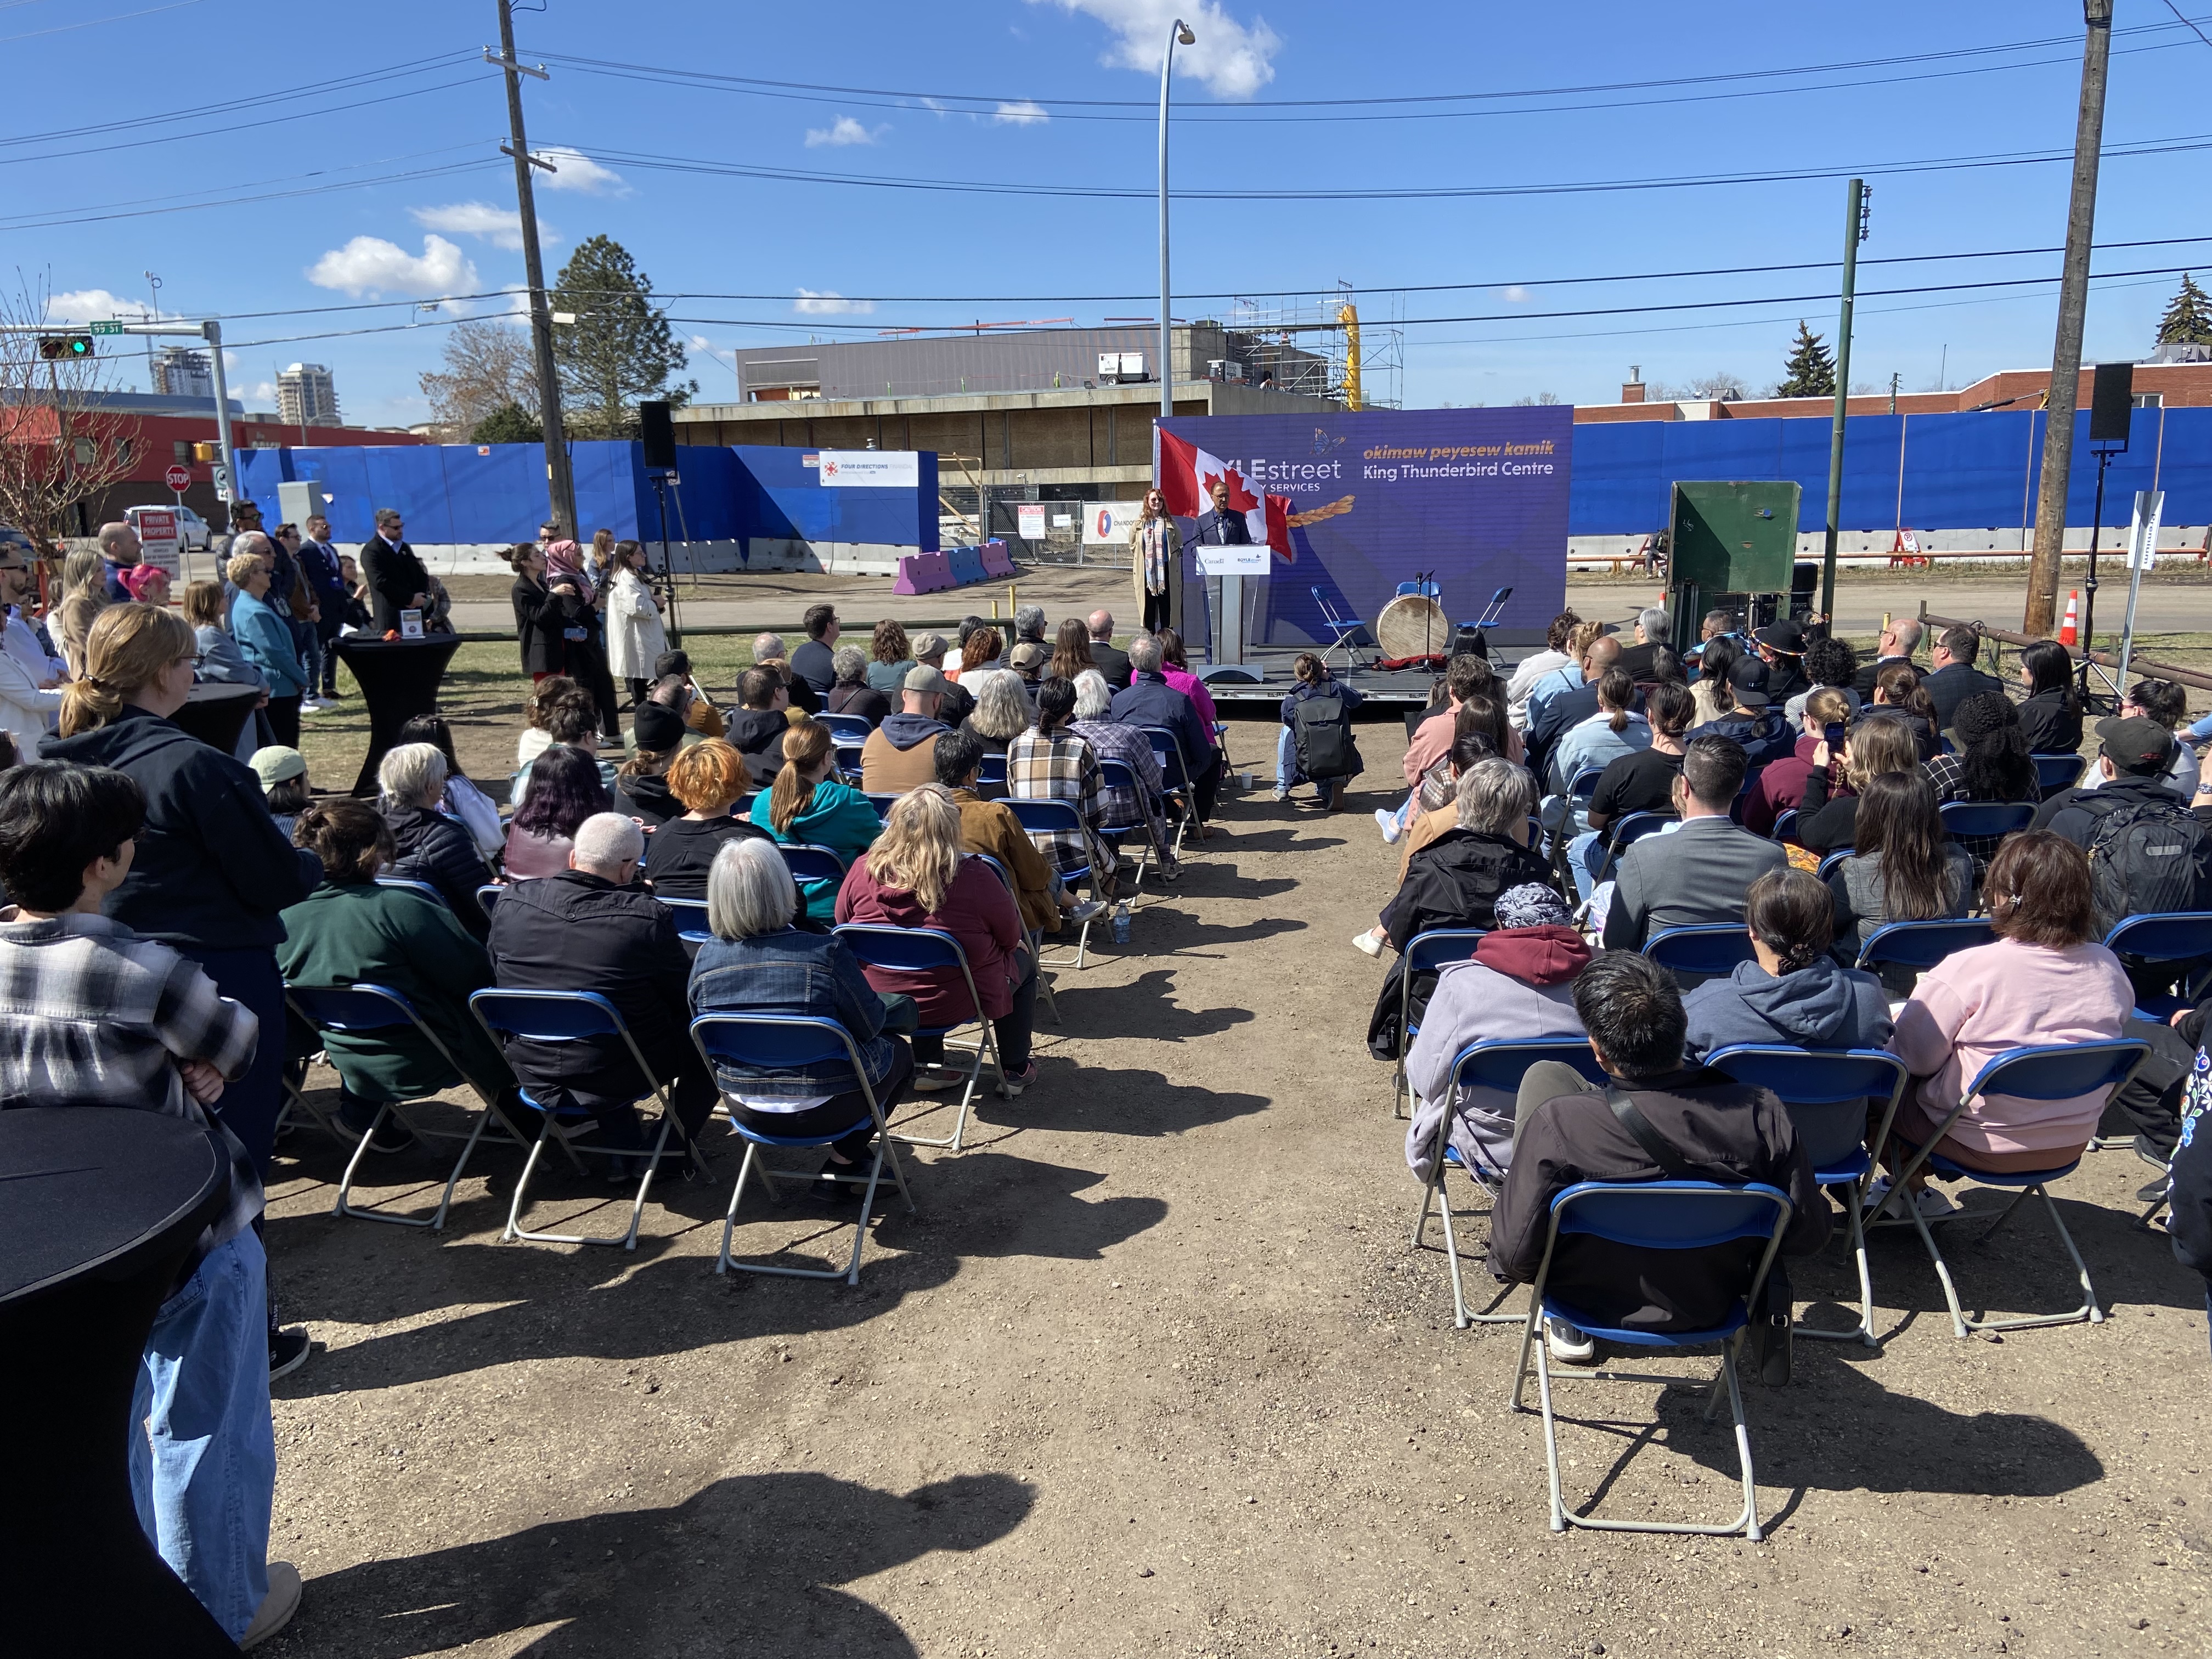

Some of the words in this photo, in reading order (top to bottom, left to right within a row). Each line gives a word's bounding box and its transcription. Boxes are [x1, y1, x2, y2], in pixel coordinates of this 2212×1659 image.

[94, 323, 105, 333] 99
[110, 323, 120, 333] ST
[1363, 444, 1428, 460] okimaw
[1429, 444, 1502, 461] peyesew
[1503, 440, 1555, 456] kamik
[1363, 465, 1397, 482] King
[1401, 462, 1498, 478] Thunderbird
[1502, 461, 1554, 476] Centre
[168, 473, 189, 484] STOP
[1270, 482, 1321, 492] SERVICES
[145, 515, 170, 524] PRIVATE
[143, 526, 175, 535] PROPERTY
[2143, 514, 2156, 565] Premium
